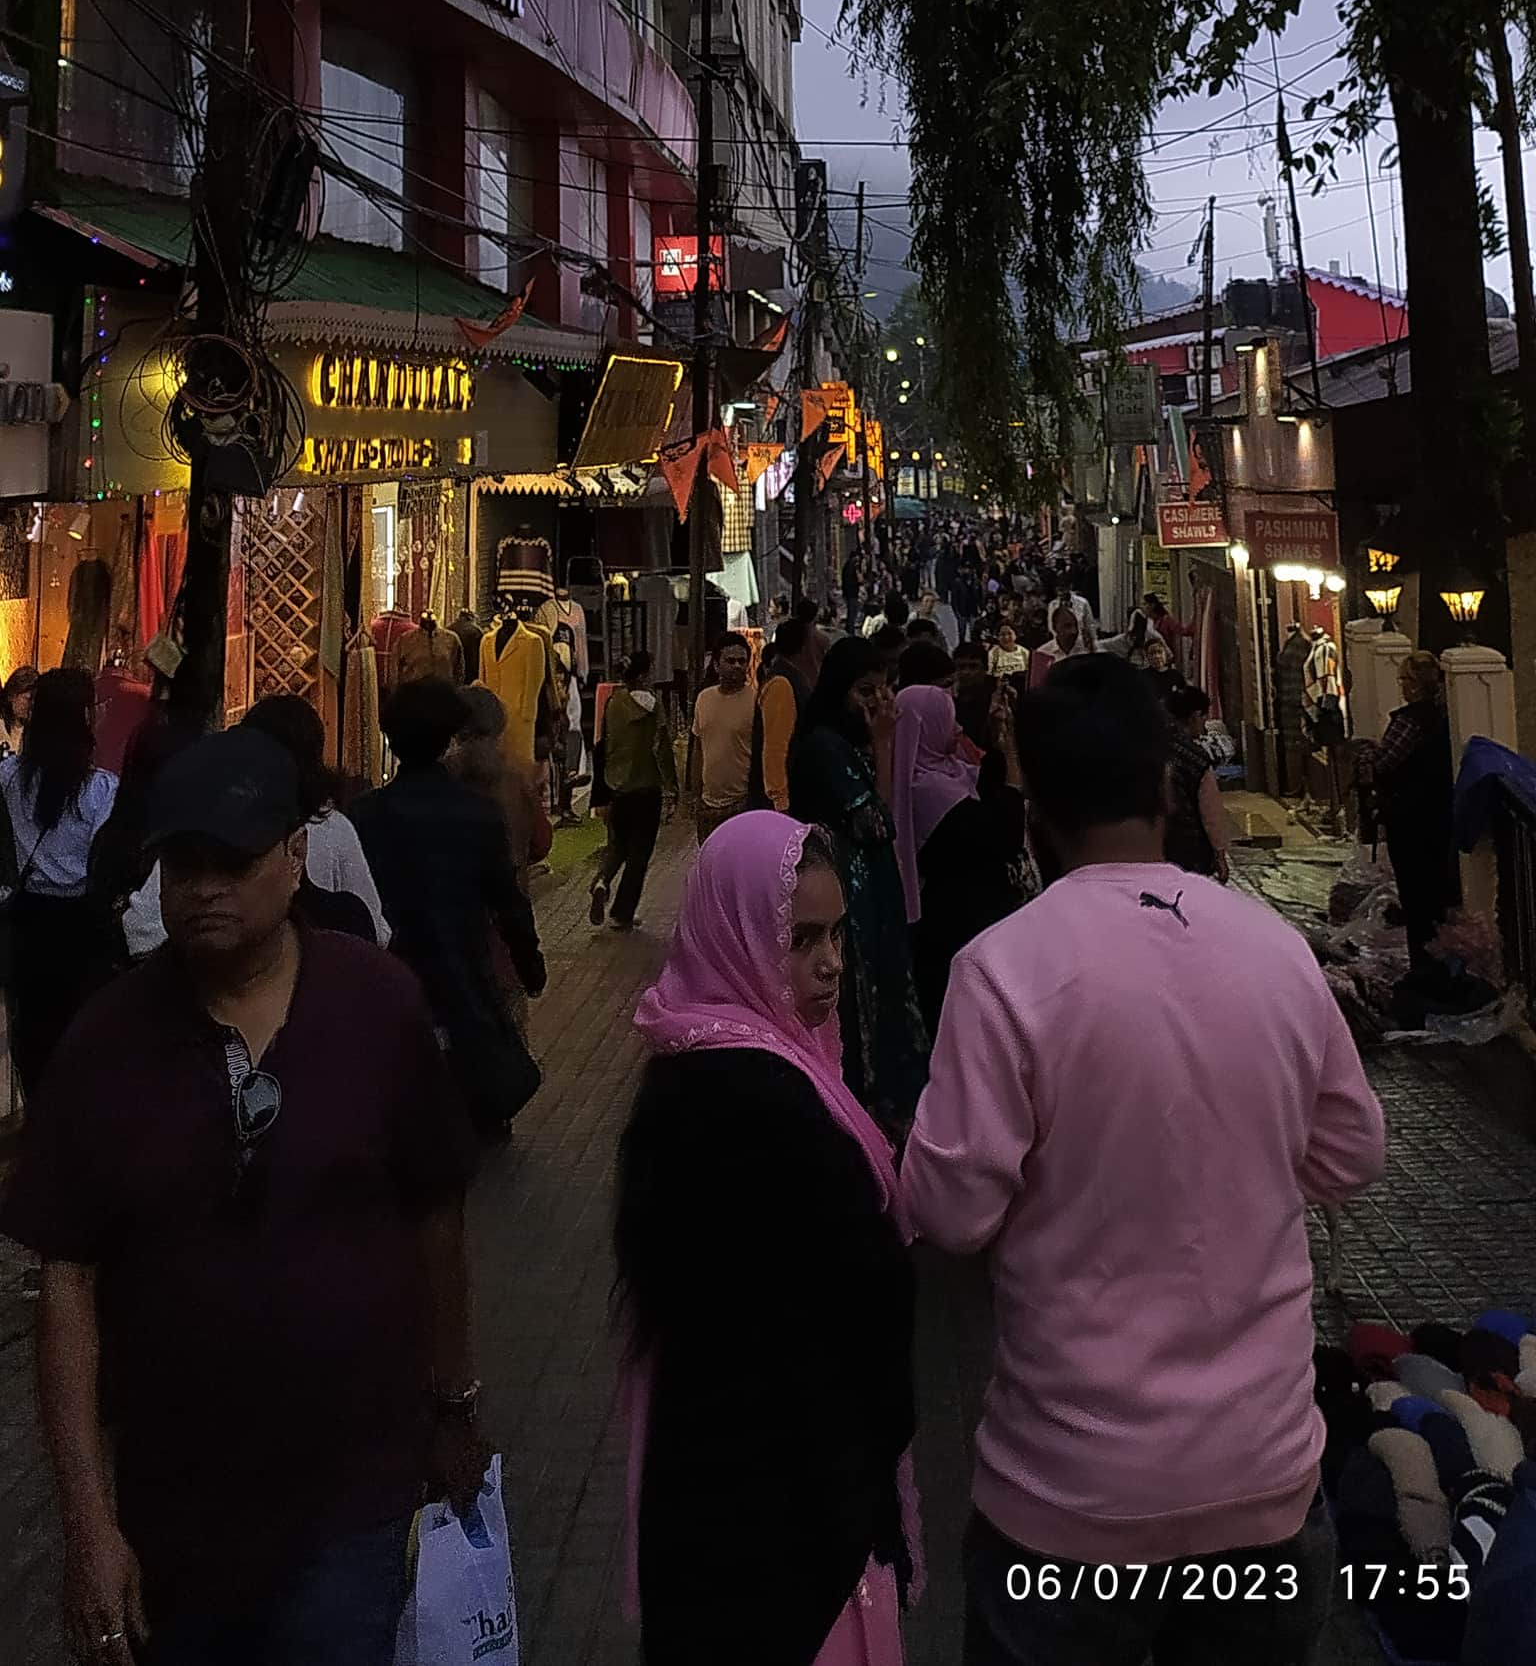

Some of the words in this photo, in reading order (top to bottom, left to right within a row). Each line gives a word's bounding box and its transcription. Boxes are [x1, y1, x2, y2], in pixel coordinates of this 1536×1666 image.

[1171, 525, 1217, 539] SHAWLS
[1254, 519, 1329, 540] PASHMINA
[1264, 542, 1322, 560] SHAWLS
